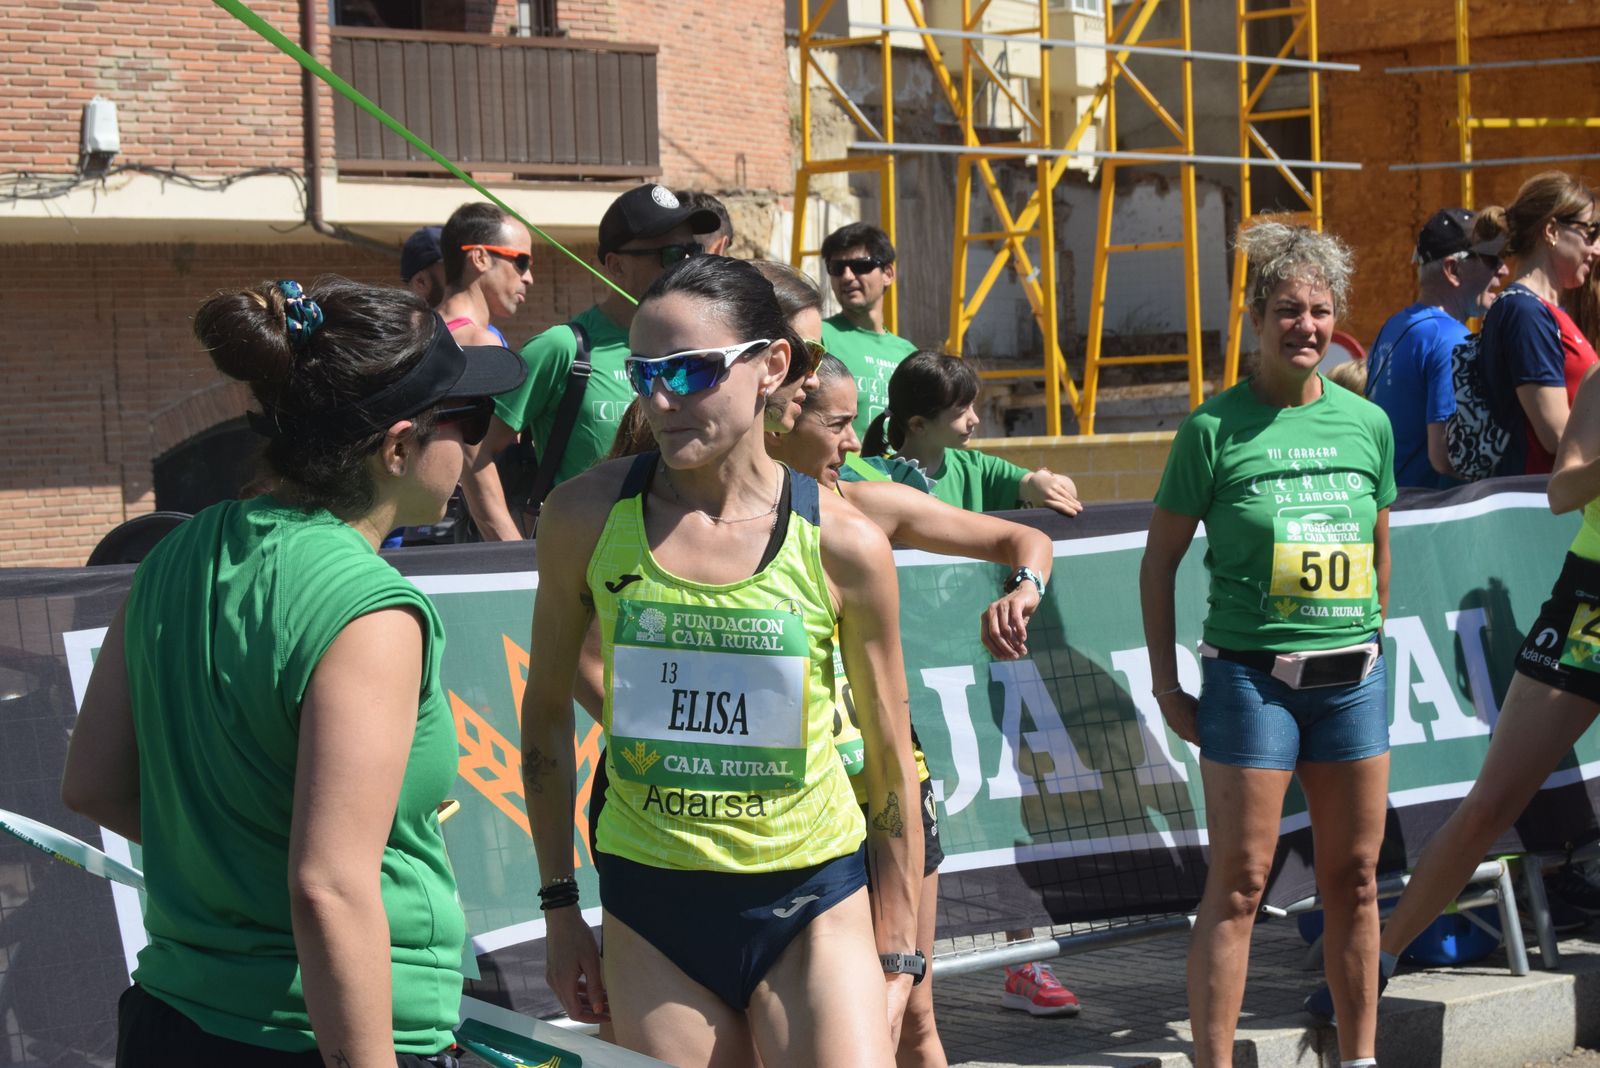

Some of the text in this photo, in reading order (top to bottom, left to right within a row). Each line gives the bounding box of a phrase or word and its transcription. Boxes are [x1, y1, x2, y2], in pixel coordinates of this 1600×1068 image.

[1288, 446, 1338, 460] CARRERA
[1298, 490, 1350, 503] ZAMORA
[1304, 531, 1361, 543] CAJA RURAL
[1300, 550, 1350, 592] 50
[1300, 604, 1365, 618] CAJA RURAL
[672, 612, 785, 635] FUNDACION
[671, 629, 784, 651] CAJA RURAL
[1521, 647, 1560, 670] Adarsa
[660, 662, 678, 684] 13
[667, 688, 750, 736] ELISA
[920, 658, 1104, 817] JA
[663, 754, 794, 777] CAJA RURAL
[642, 783, 768, 819] Adarsa
